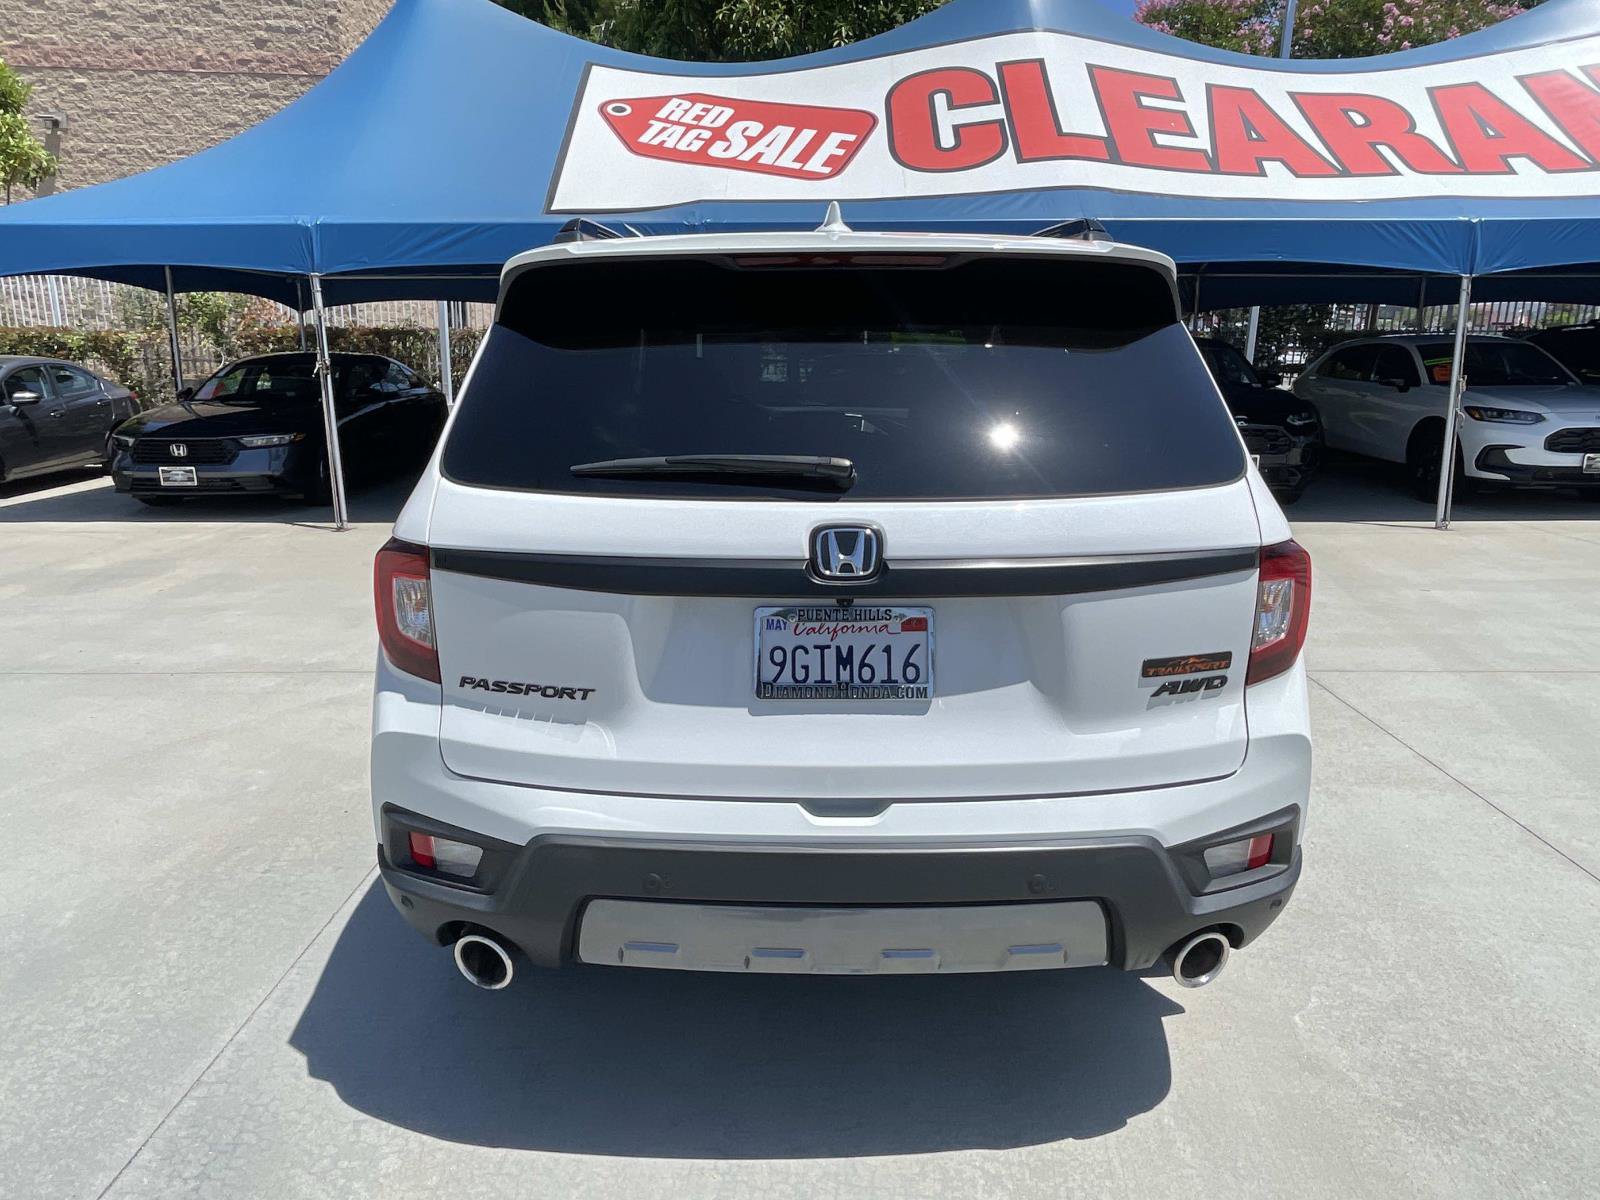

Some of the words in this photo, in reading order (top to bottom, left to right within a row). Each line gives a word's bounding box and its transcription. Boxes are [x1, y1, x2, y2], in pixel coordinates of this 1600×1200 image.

[655, 98, 735, 128] RED
[637, 120, 713, 152] TAG
[707, 120, 858, 174] SALE
[766, 618, 788, 631] MAY
[797, 608, 849, 621] PUENTE
[855, 608, 892, 621] HILLS
[793, 622, 901, 642] California
[769, 644, 921, 684] 9GIM616
[458, 676, 597, 701] PASSPORT
[1150, 675, 1228, 698] AWD
